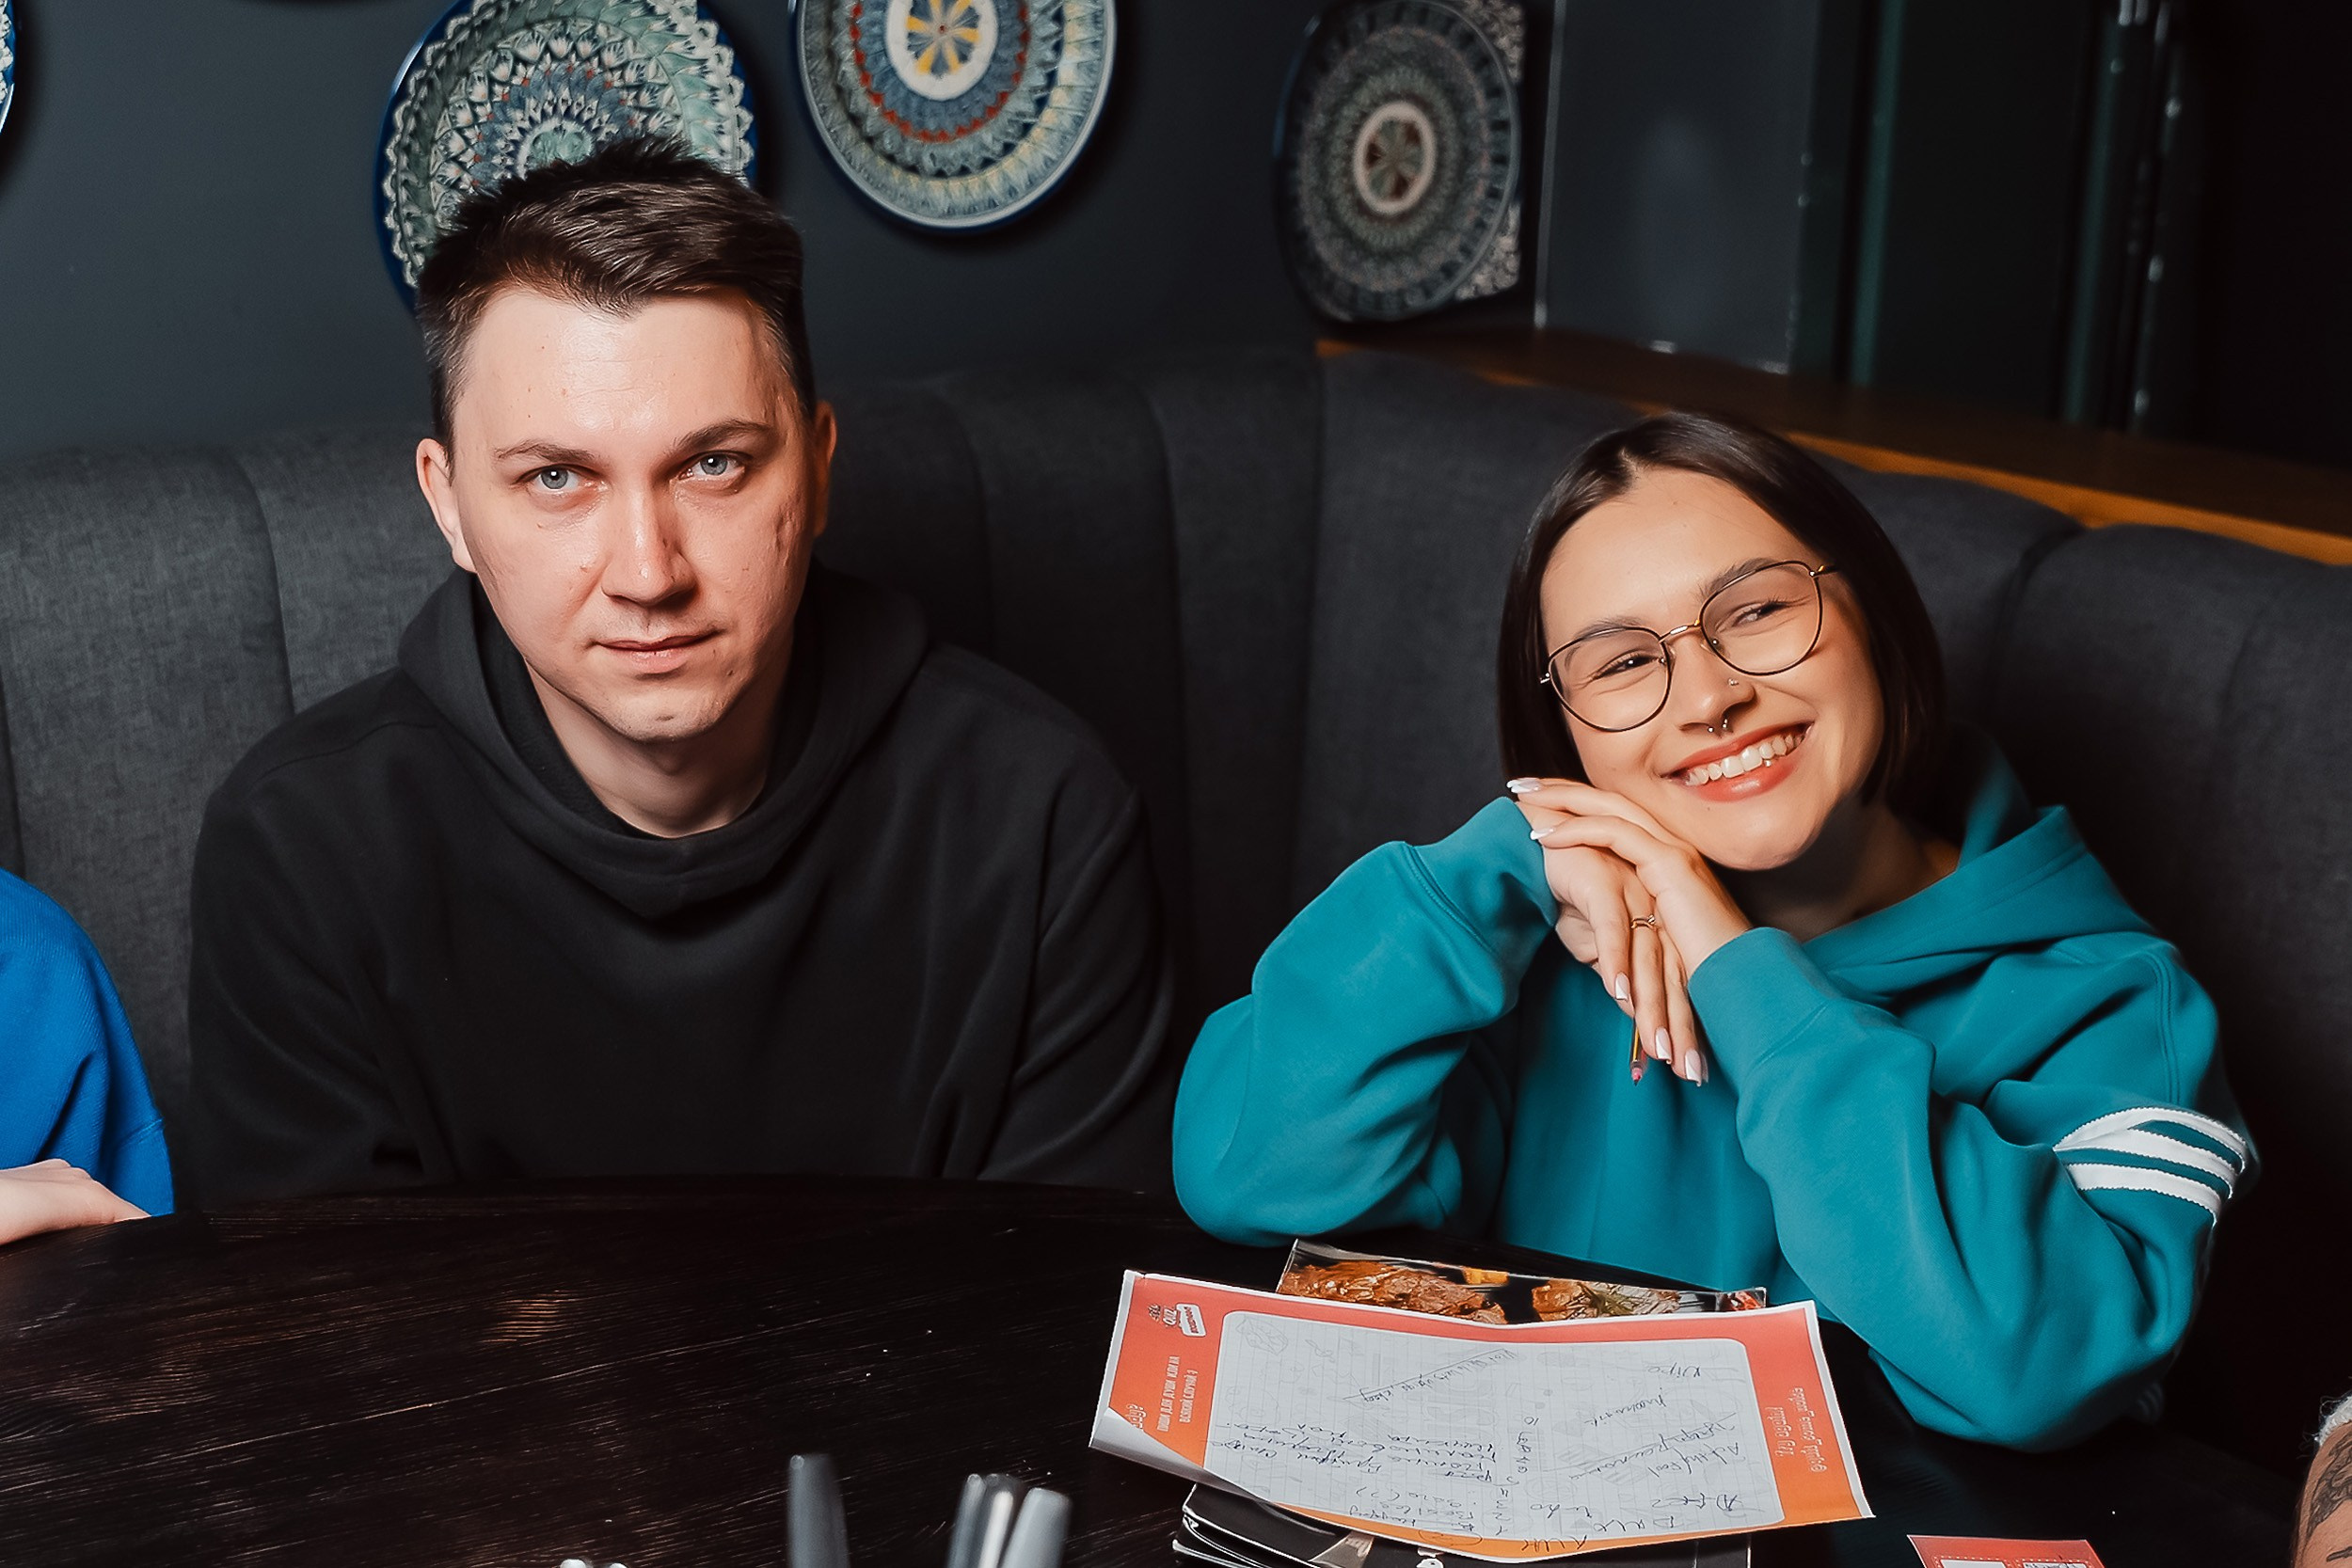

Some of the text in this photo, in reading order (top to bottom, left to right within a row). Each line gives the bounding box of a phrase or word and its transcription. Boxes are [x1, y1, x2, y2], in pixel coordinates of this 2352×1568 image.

[1167, 1364, 1179, 1378] ИЛИ
[1163, 1379, 1176, 1399] ДУШИ
[1183, 1374, 1198, 1400] СЛУЧАЙ
[1161, 1399, 1173, 1415] ДЛЯ
[1179, 1399, 1194, 1423] ВСЯКИЙ
[1774, 1440, 1796, 1457] Try
